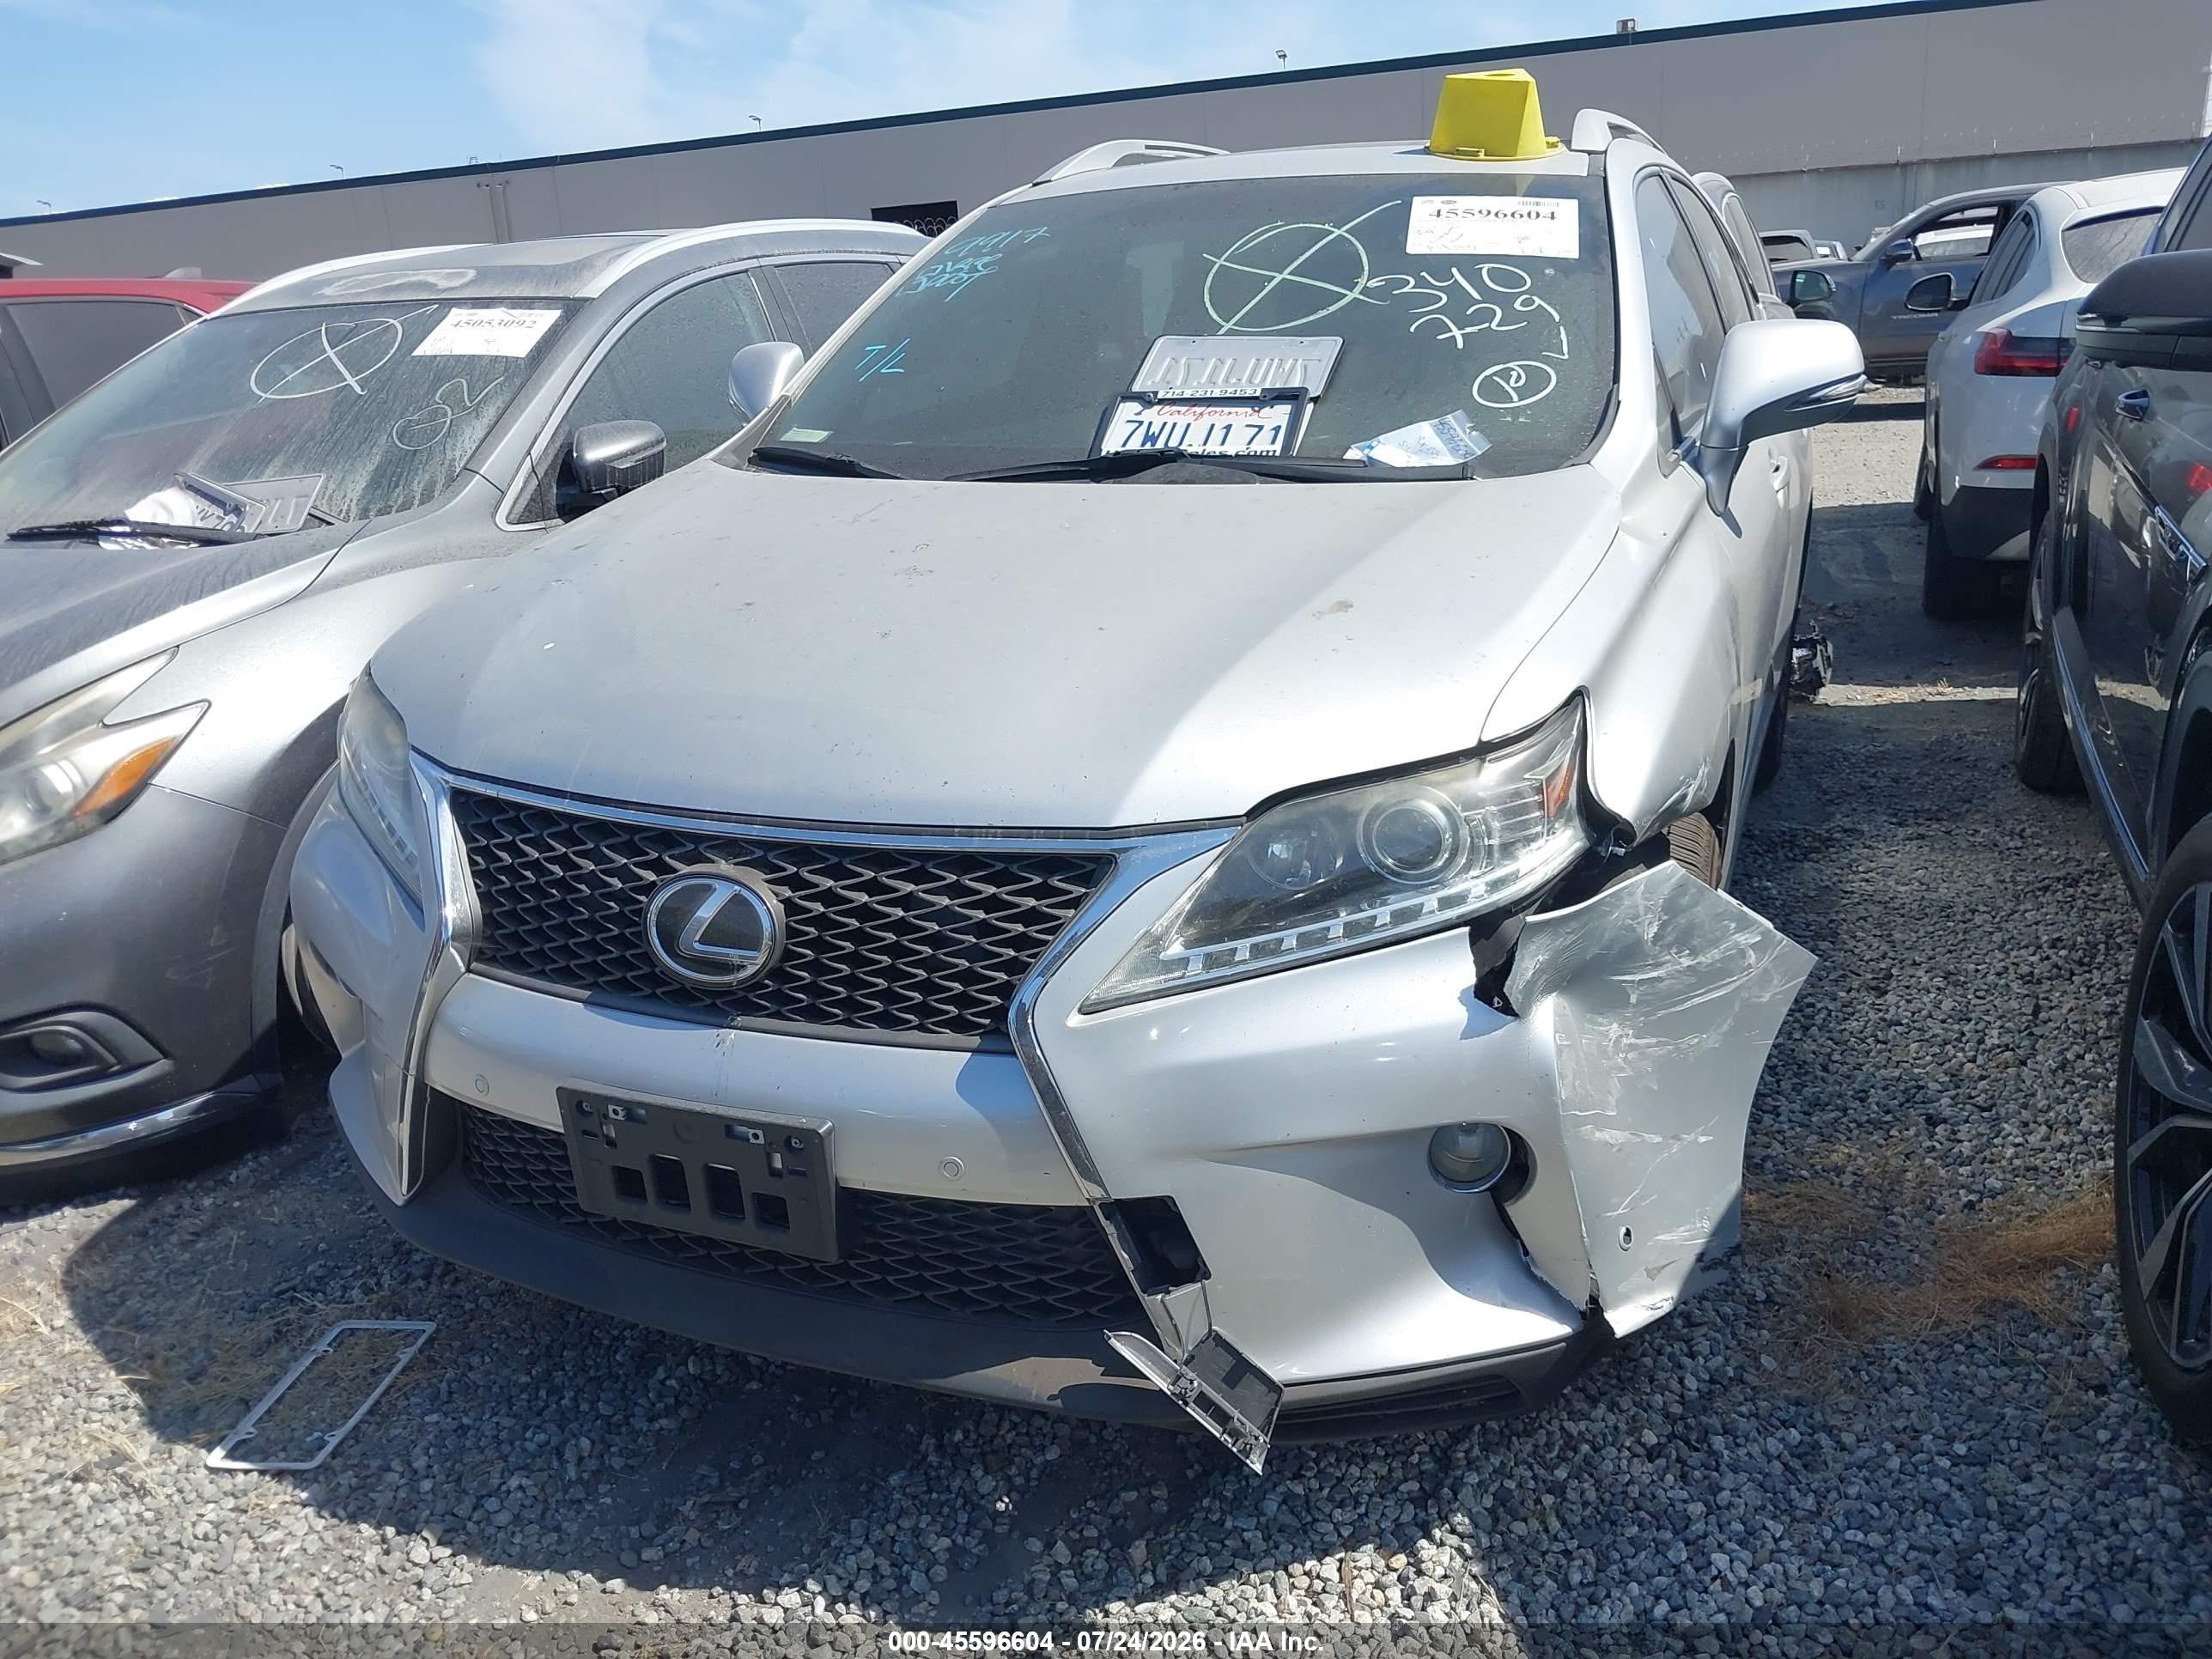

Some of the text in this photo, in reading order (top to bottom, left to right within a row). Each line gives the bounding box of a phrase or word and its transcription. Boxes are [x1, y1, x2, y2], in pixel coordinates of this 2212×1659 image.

[1428, 208, 1557, 222] 45596604
[1366, 263, 1532, 313] 340
[449, 319, 538, 329] 45053092
[1159, 388, 1258, 398] 714-231-9453
[1157, 401, 1272, 422] California
